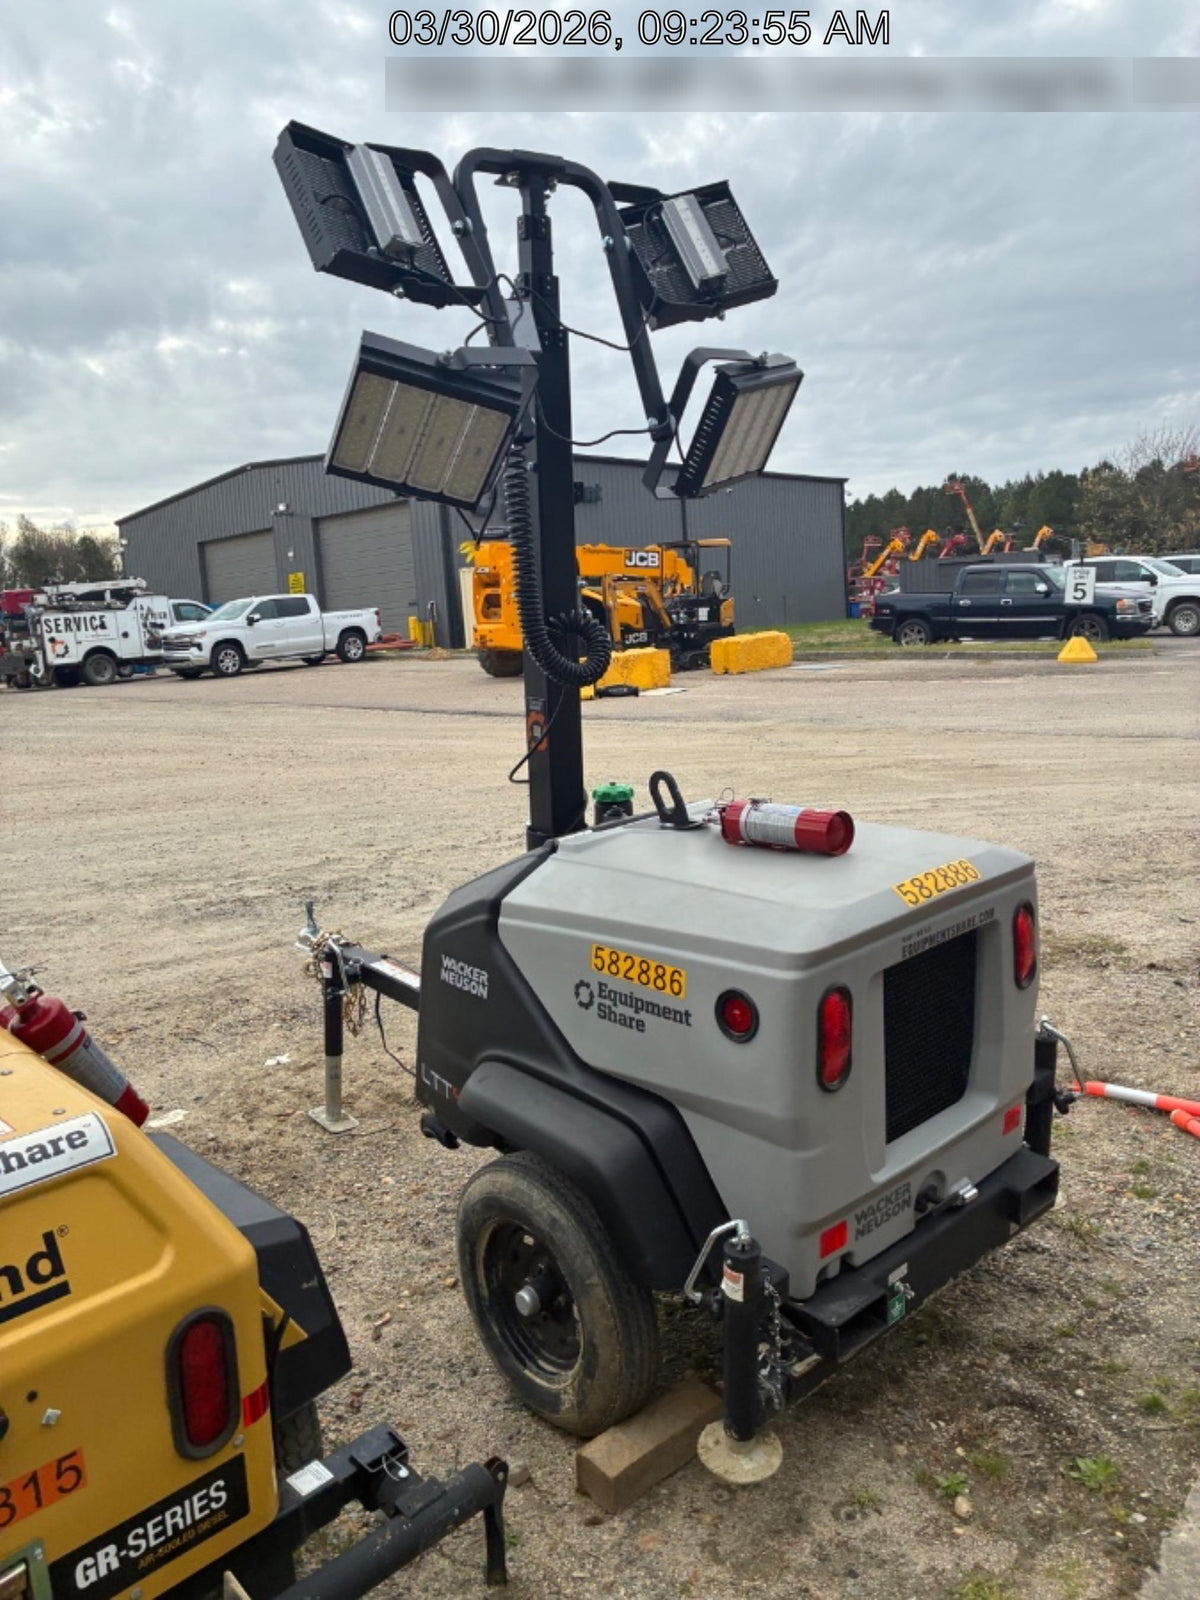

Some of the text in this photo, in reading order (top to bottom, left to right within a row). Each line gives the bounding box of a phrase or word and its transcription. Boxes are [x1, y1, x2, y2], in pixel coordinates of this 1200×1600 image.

[625, 551, 659, 566] JCB
[1072, 582, 1087, 600] 5
[43, 615, 107, 634] SERVICE
[624, 632, 648, 645] JCB
[896, 860, 979, 905] 582886
[440, 968, 488, 999] NEUSON
[441, 953, 488, 986] WACKER
[593, 946, 683, 996] 582886
[597, 981, 693, 1027] Equipment
[597, 1002, 646, 1034] Share
[0, 1129, 89, 1176] hare
[854, 1182, 912, 1226] WACKER
[854, 1194, 911, 1242] NEUSON
[75, 1479, 228, 1590] GR-SERIES
